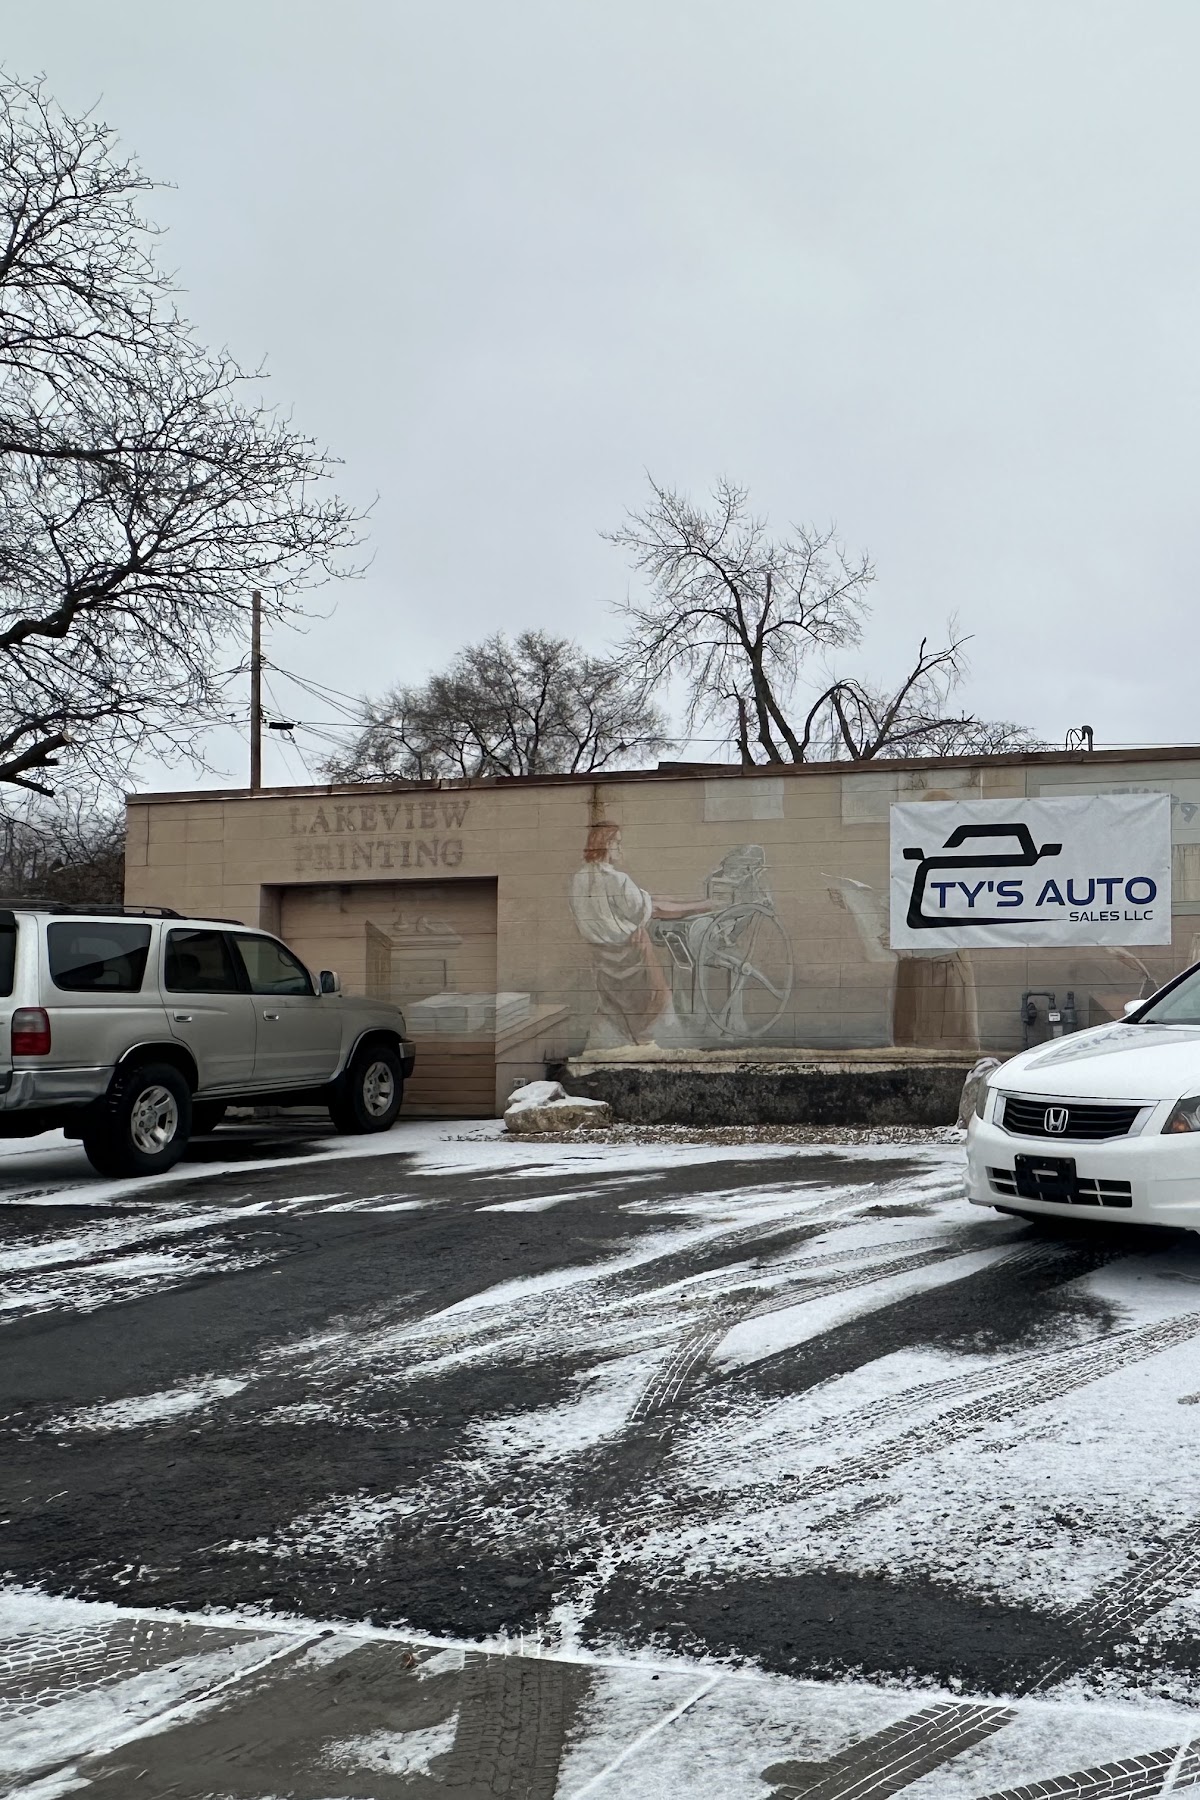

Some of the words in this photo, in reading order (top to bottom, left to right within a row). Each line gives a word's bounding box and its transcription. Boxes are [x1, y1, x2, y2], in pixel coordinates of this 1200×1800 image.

[288, 800, 471, 835] LAKEVIEW
[293, 837, 464, 871] PRINTING
[930, 880, 1024, 908] TY'S
[1035, 876, 1157, 906] AUTO
[1068, 910, 1120, 922] SALES
[1124, 909, 1154, 921] LLC
